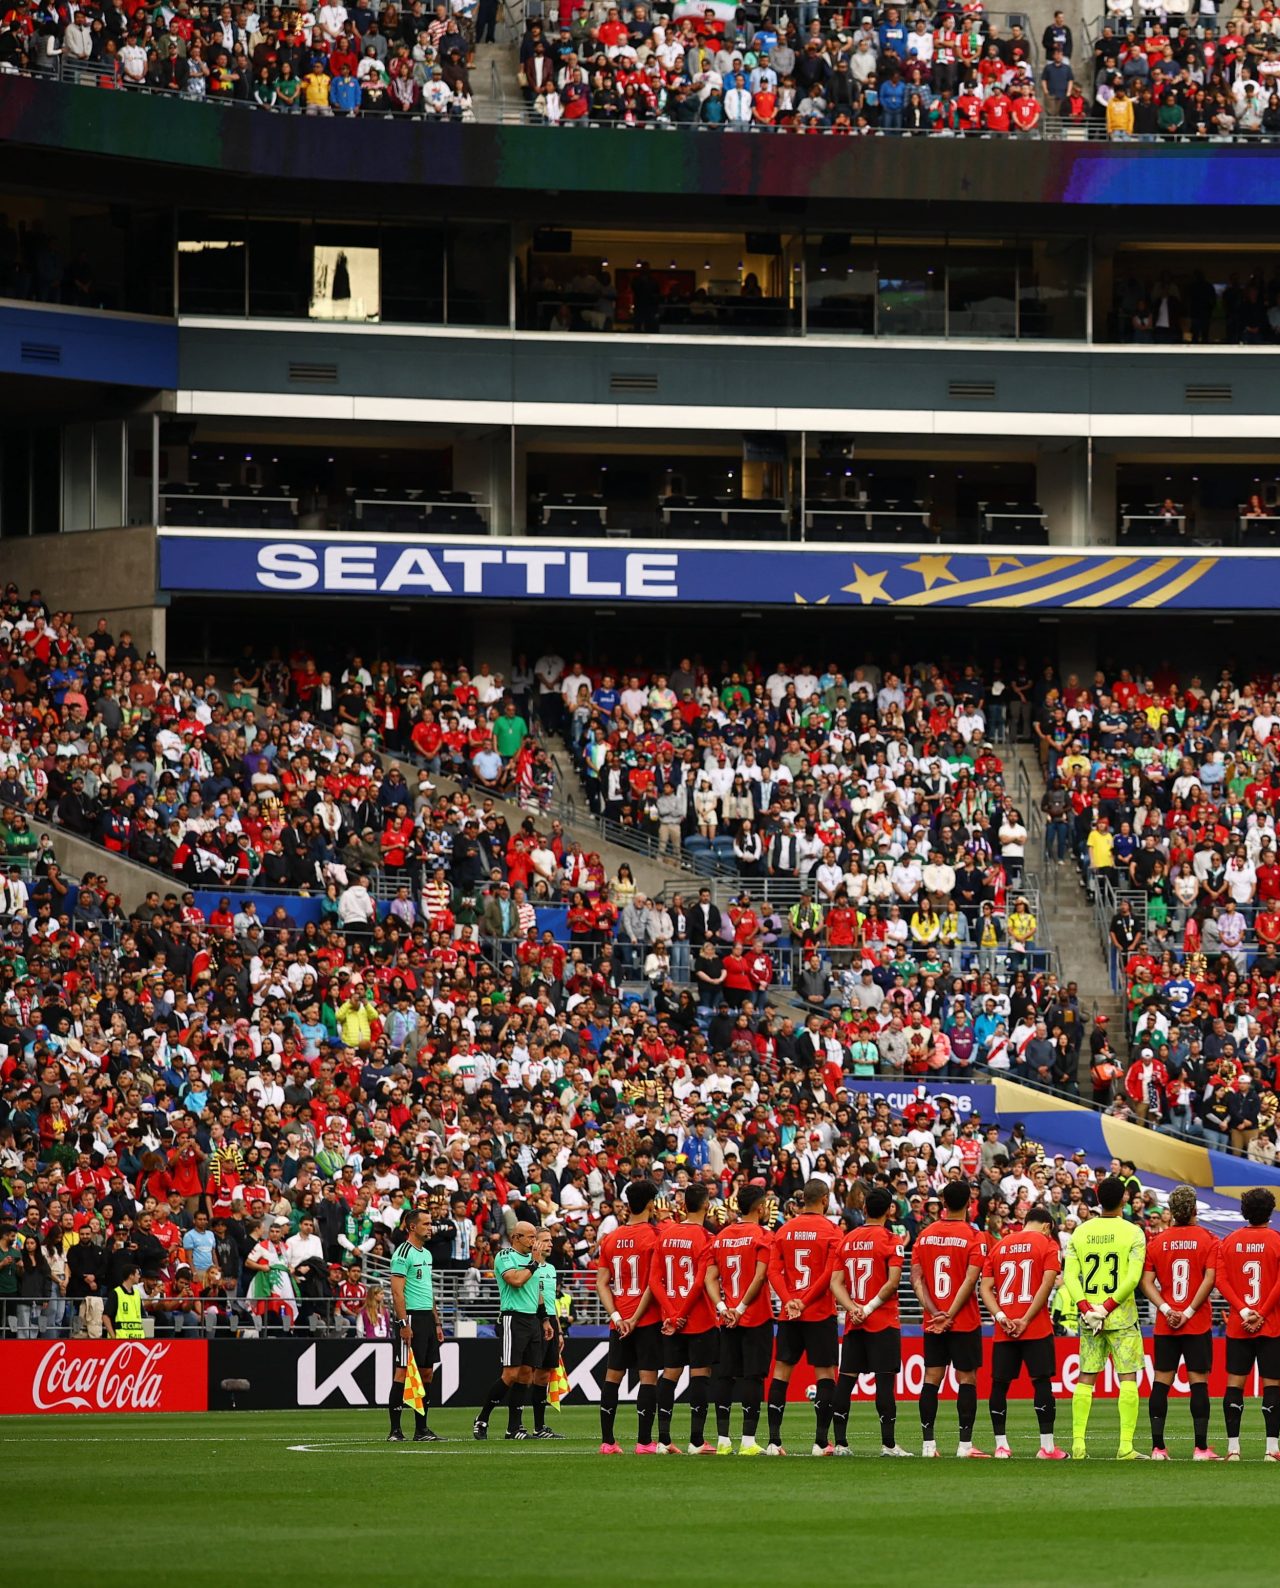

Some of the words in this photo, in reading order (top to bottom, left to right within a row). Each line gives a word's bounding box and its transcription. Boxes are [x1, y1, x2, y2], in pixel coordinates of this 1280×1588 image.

[256, 544, 678, 597] SEATTLE
[616, 1239, 634, 1249] ZICO
[1009, 1243, 1032, 1254] SABER
[1170, 1240, 1198, 1250] ASHOUR
[1236, 1243, 1245, 1253] M.
[1246, 1243, 1265, 1253] HANY
[611, 1255, 641, 1297] 11
[664, 1254, 694, 1298] 13
[726, 1254, 742, 1299] 7
[794, 1248, 812, 1290] 5
[845, 1257, 875, 1300] 17
[933, 1255, 951, 1300] 6
[999, 1259, 1034, 1306] 21
[1084, 1252, 1120, 1295] 23
[1171, 1258, 1190, 1302] 8
[1242, 1260, 1262, 1305] 3
[32, 1341, 171, 1410] Coca-Cola
